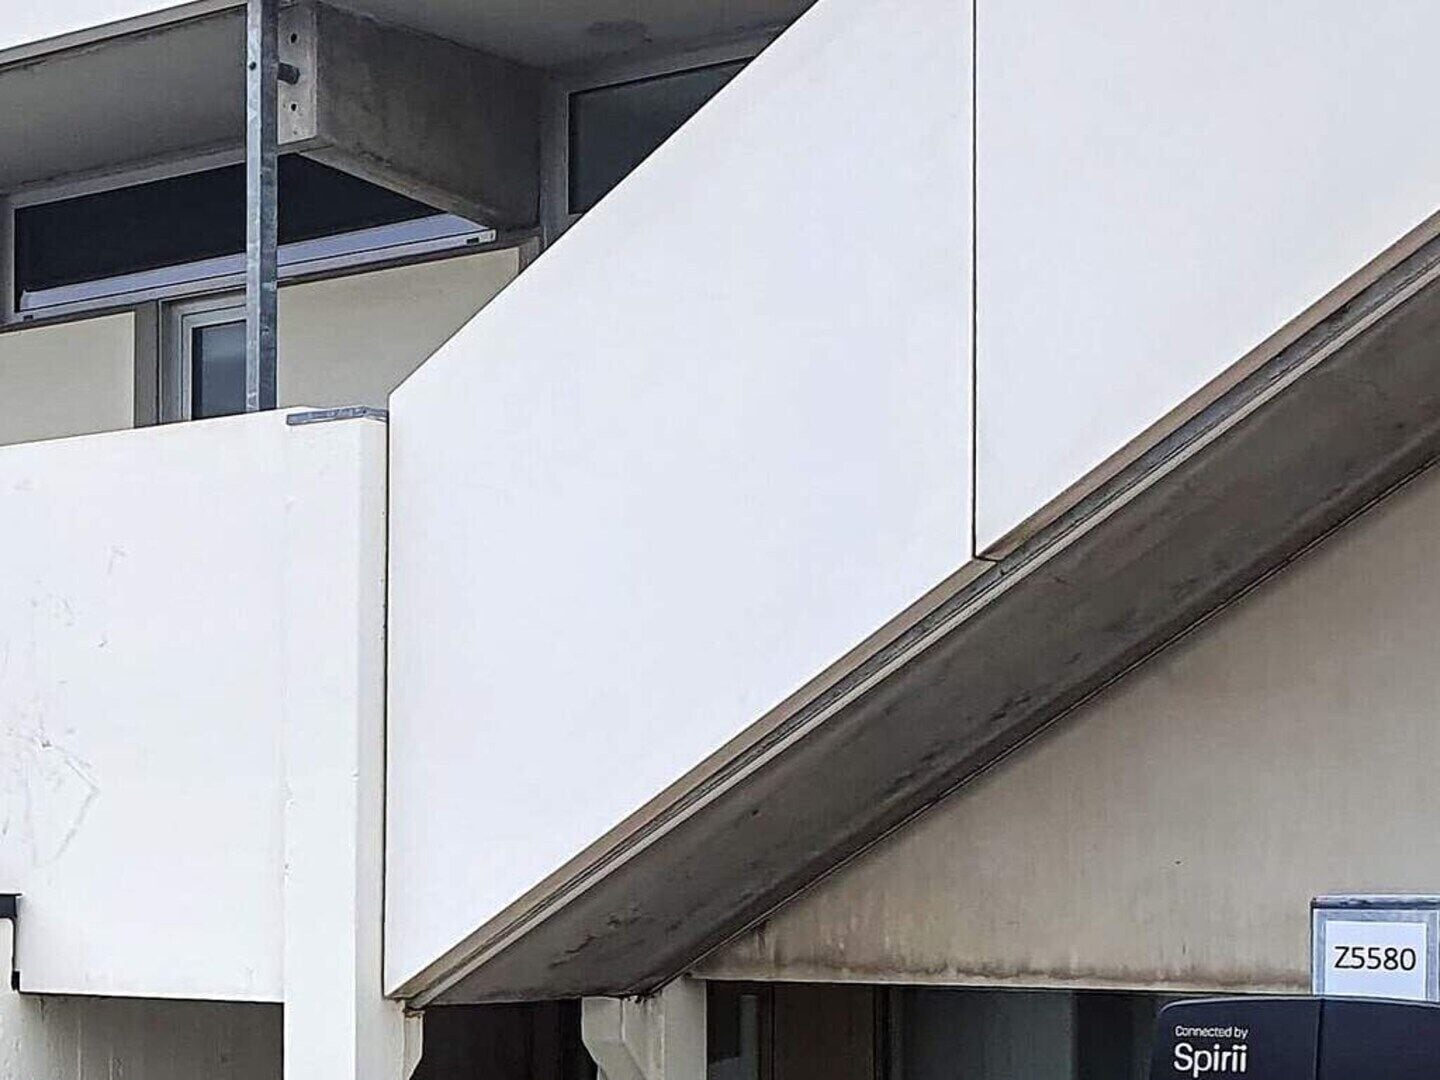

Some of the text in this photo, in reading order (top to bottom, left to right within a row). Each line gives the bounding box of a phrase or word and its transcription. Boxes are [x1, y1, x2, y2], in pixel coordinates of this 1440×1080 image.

[1333, 945, 1417, 971] Z5580
[1175, 1025, 1249, 1040] Connected by
[1173, 1042, 1248, 1078] Spirii
